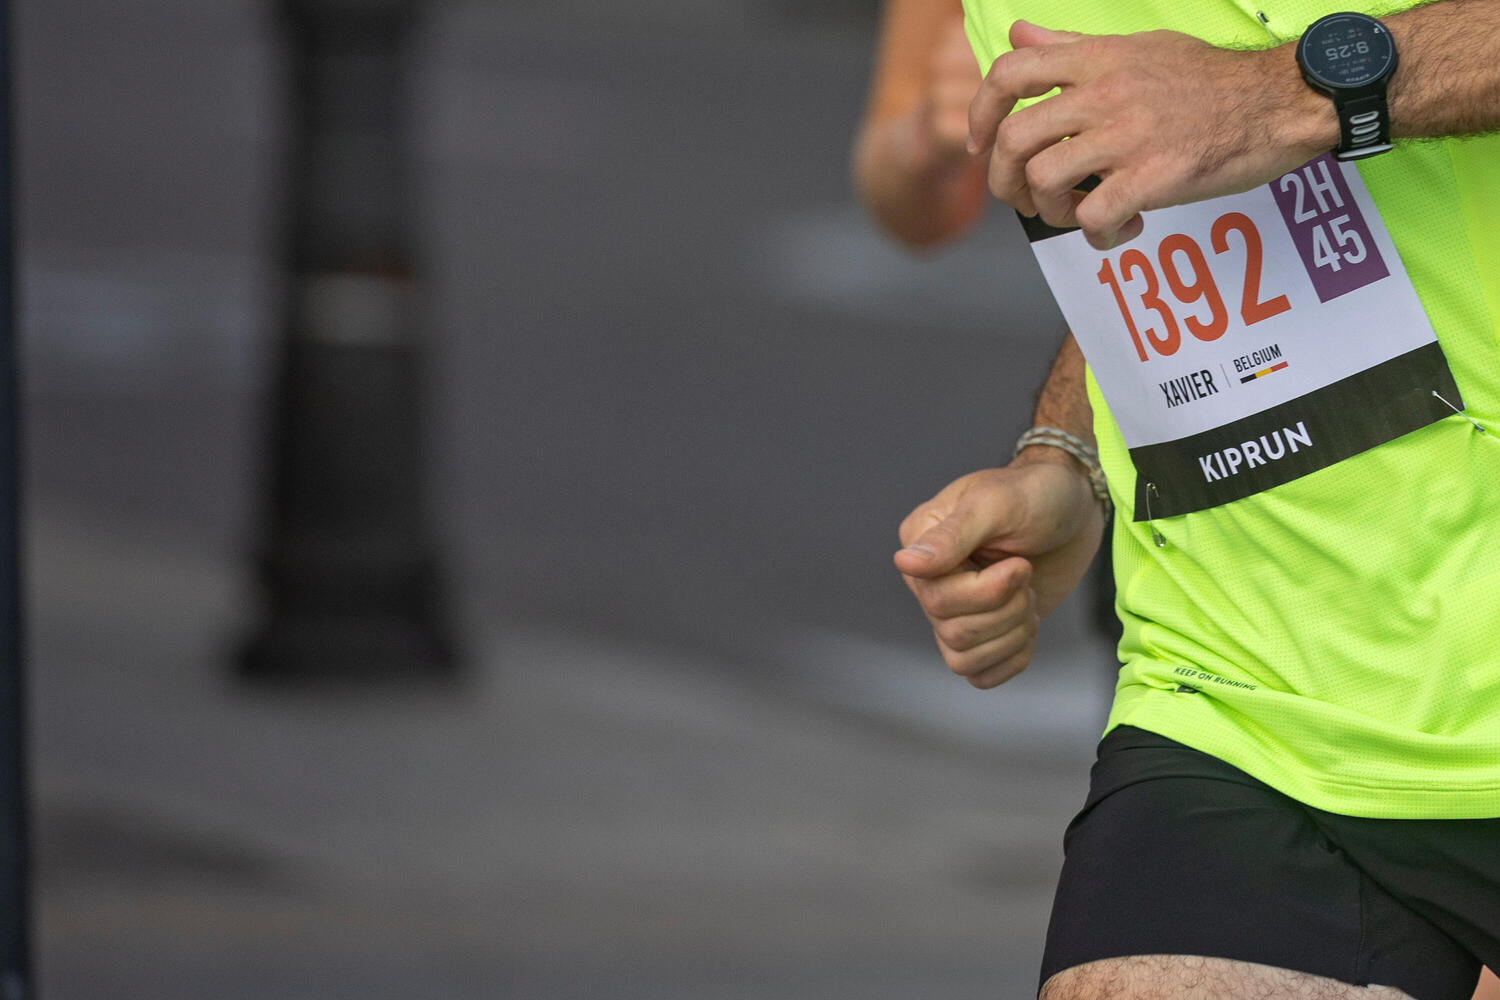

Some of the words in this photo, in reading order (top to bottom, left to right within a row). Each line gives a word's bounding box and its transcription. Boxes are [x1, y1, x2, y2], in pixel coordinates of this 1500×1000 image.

[1325, 41, 1370, 61] 9:25
[1280, 160, 1345, 224] 2H
[1312, 214, 1367, 272] 45
[1096, 211, 1292, 363] 1392
[1233, 343, 1282, 373] BELGIUM
[1159, 369, 1219, 408] XAVIER
[1198, 421, 1313, 482] KIPRUN
[1174, 667, 1197, 677] KEEP
[1198, 672, 1212, 681] ON
[1214, 676, 1256, 690] RUNNING
